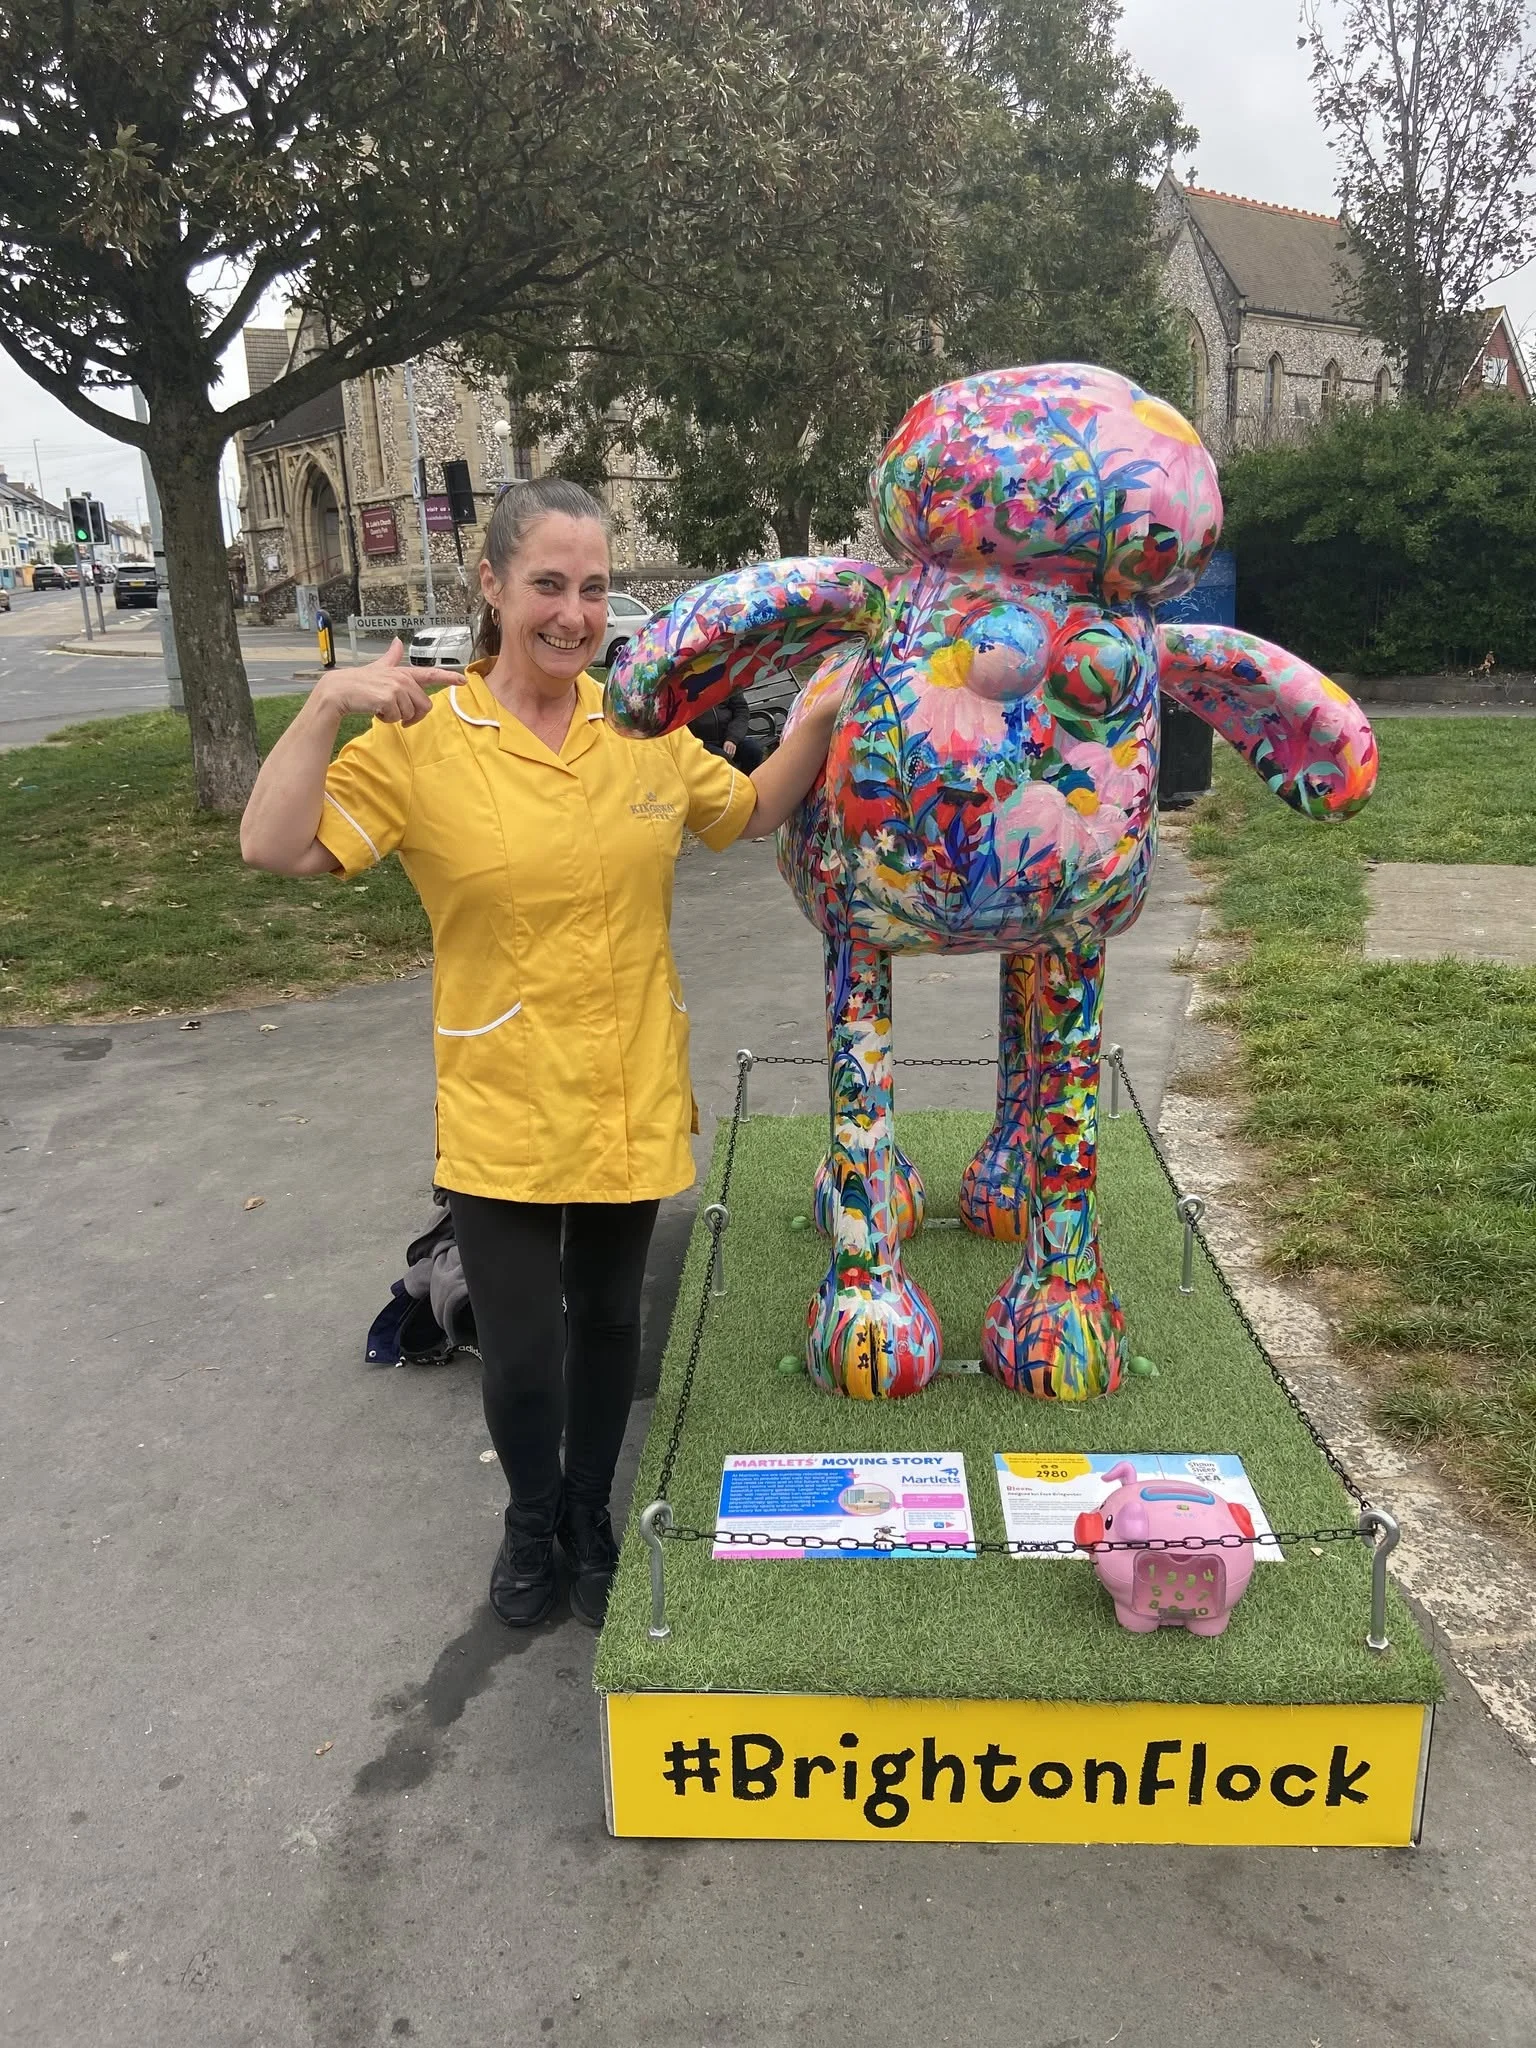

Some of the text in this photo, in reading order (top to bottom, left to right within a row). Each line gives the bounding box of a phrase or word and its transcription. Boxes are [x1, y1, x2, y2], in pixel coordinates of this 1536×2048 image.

[357, 616, 470, 627] QUEENS PARK TERRACE
[821, 1457, 888, 1466] MOVING
[891, 1457, 943, 1465] STORY
[901, 1475, 960, 1484] Martlets
[1036, 1470, 1069, 1478] 2980
[1202, 1568, 1214, 1583] 4
[1174, 1590, 1185, 1601] 6
[662, 1732, 1372, 1829] #BrightonFlock
